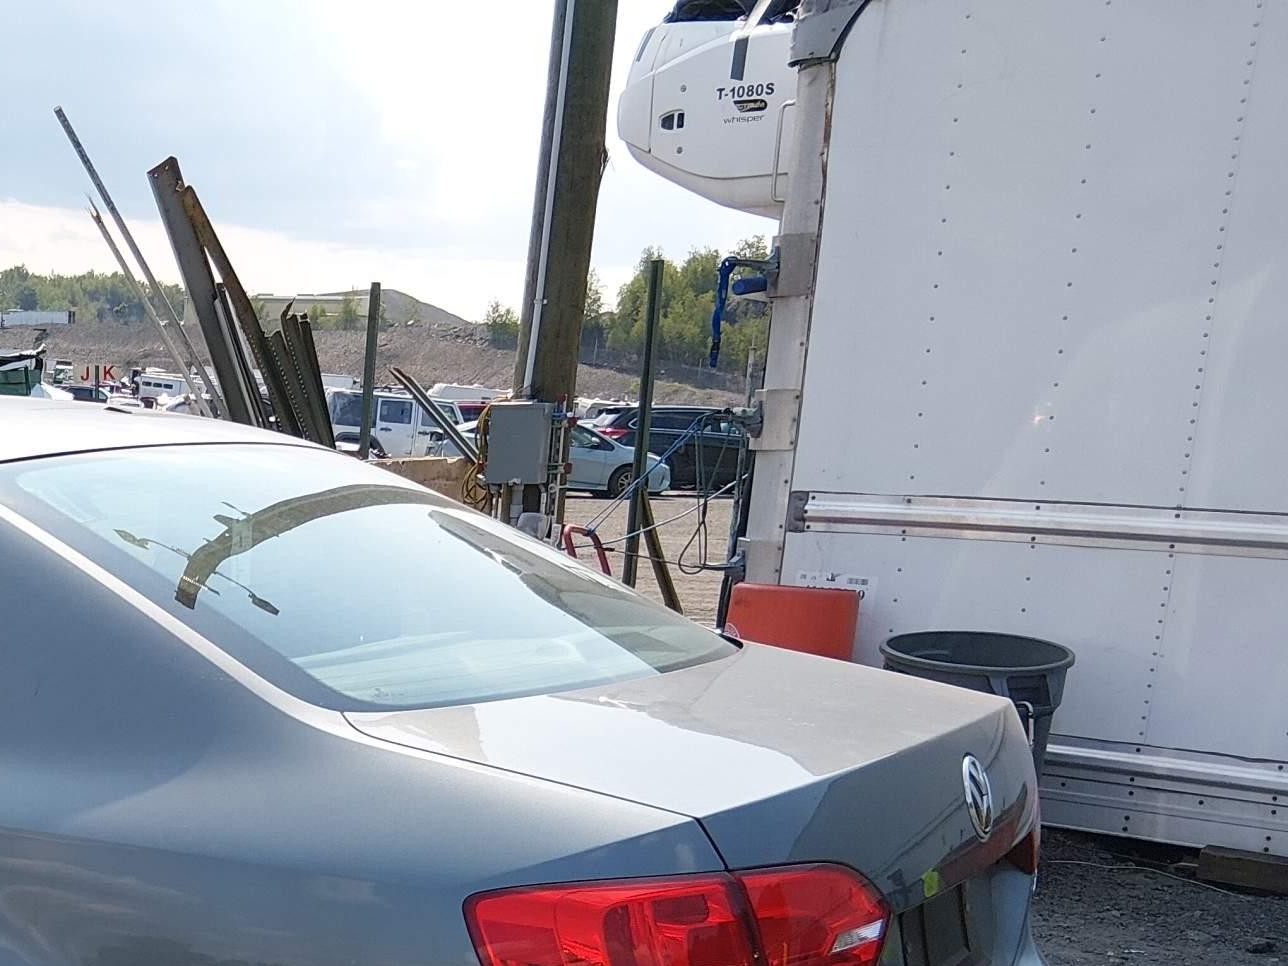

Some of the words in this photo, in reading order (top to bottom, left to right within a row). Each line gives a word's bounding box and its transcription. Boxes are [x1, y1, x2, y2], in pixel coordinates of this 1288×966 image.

[716, 82, 775, 100] T-1080S
[723, 115, 764, 124] whisper
[80, 366, 90, 381] J
[103, 365, 115, 380] K
